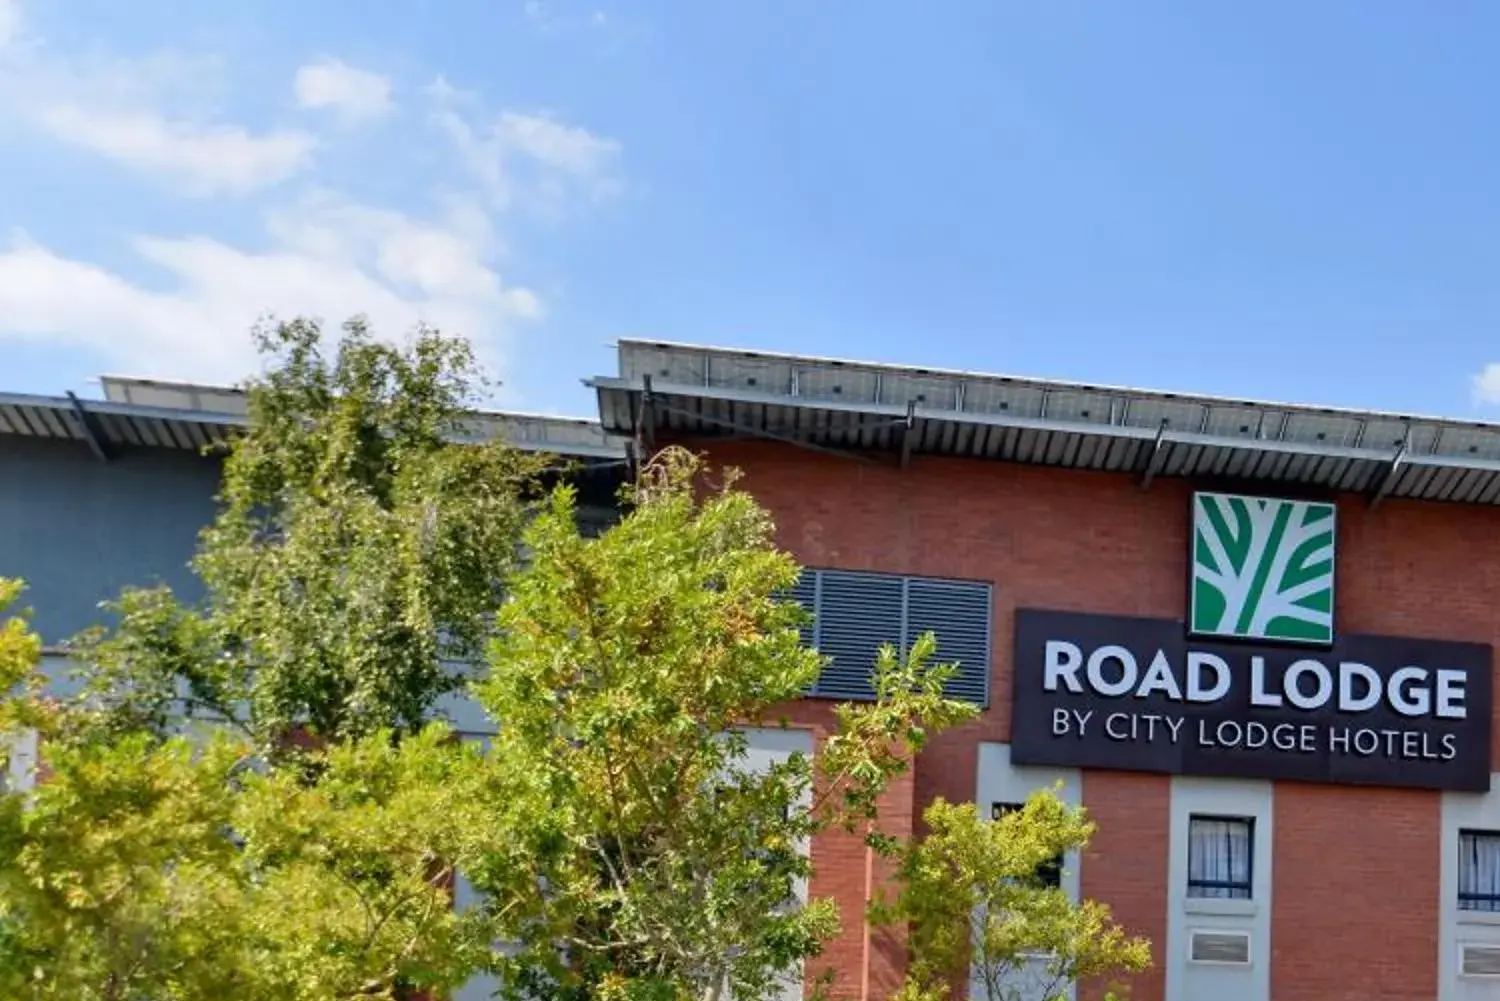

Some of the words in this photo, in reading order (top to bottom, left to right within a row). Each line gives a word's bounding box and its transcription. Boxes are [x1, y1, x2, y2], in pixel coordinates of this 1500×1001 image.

[1044, 640, 1231, 702] ROAD
[1250, 656, 1467, 718] LODGE
[1053, 708, 1093, 735] BY
[1105, 713, 1185, 742] CITY
[1199, 719, 1316, 751] LODGE
[1329, 727, 1457, 759] HOTELS
